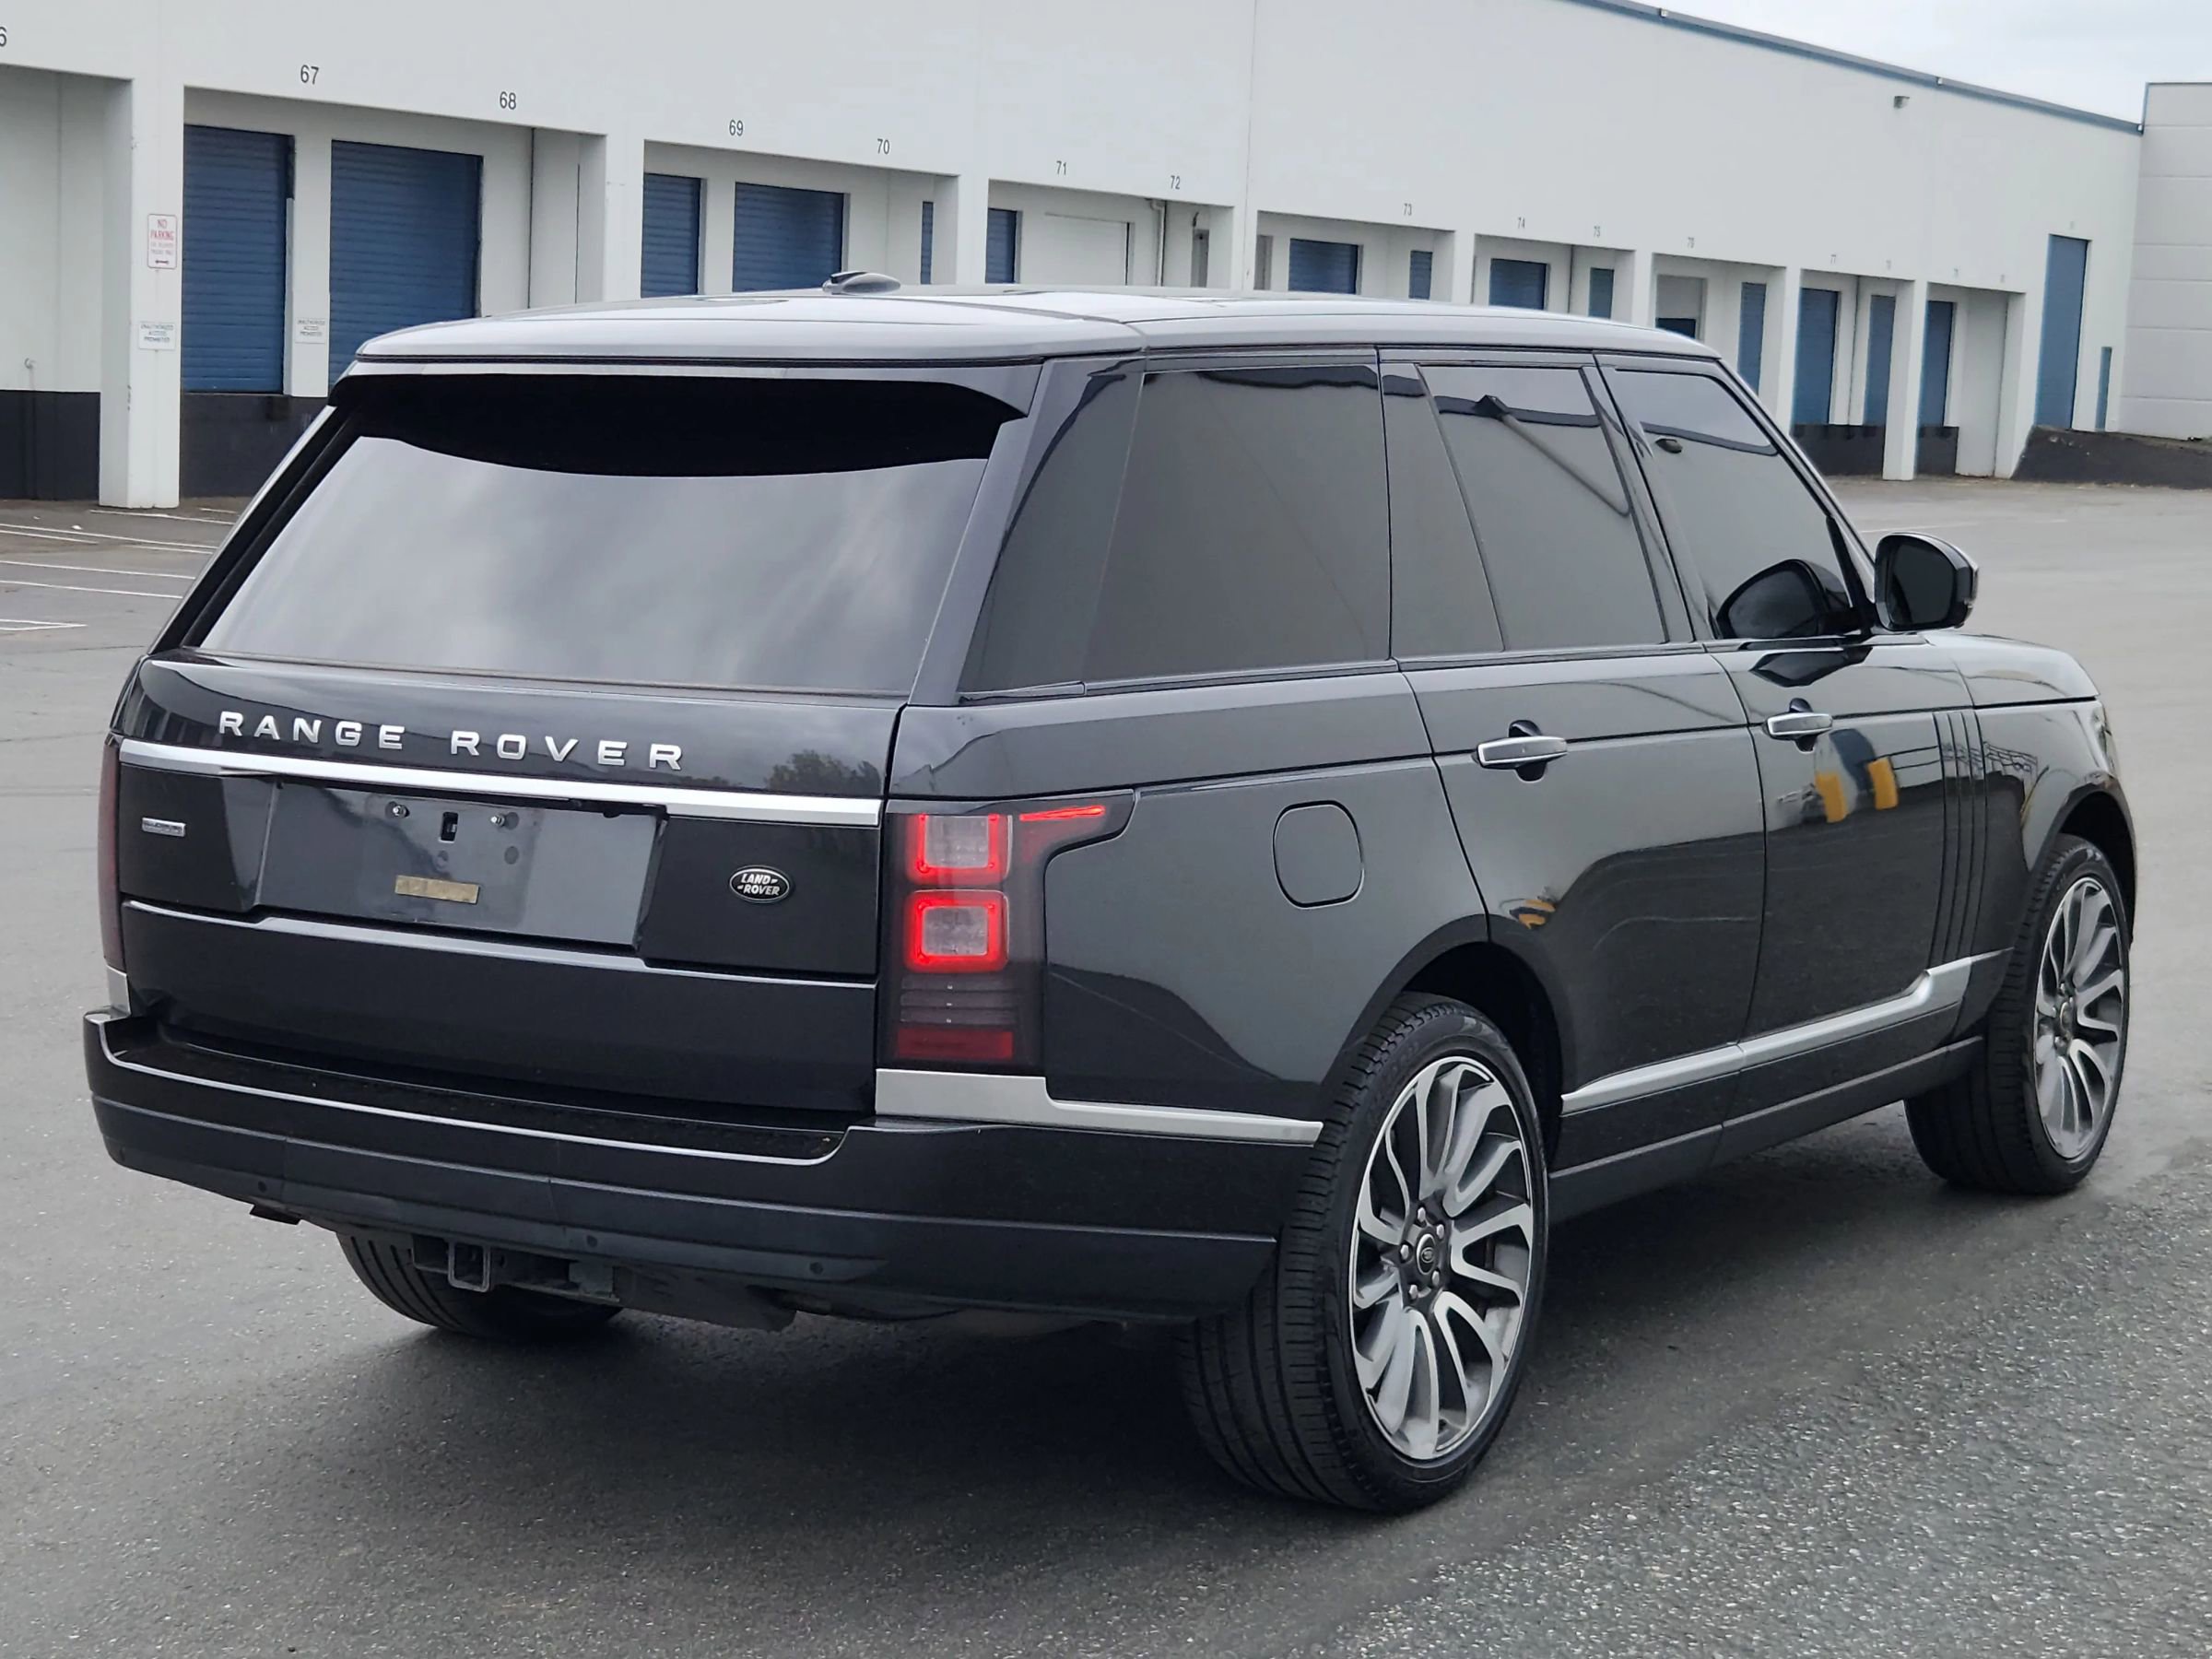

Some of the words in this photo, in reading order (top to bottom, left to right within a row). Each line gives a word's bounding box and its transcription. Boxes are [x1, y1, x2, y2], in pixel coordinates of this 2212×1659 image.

[300, 65, 319, 85] 67
[500, 91, 516, 110] 68
[729, 119, 744, 136] 69
[877, 138, 890, 155] 70
[1056, 160, 1067, 175] 71
[1171, 175, 1181, 190] 72
[157, 218, 167, 229] NO
[1517, 217, 1526, 229] 74
[150, 230, 174, 241] PARKING
[219, 711, 406, 749] RANGE
[451, 730, 682, 771] ROVER
